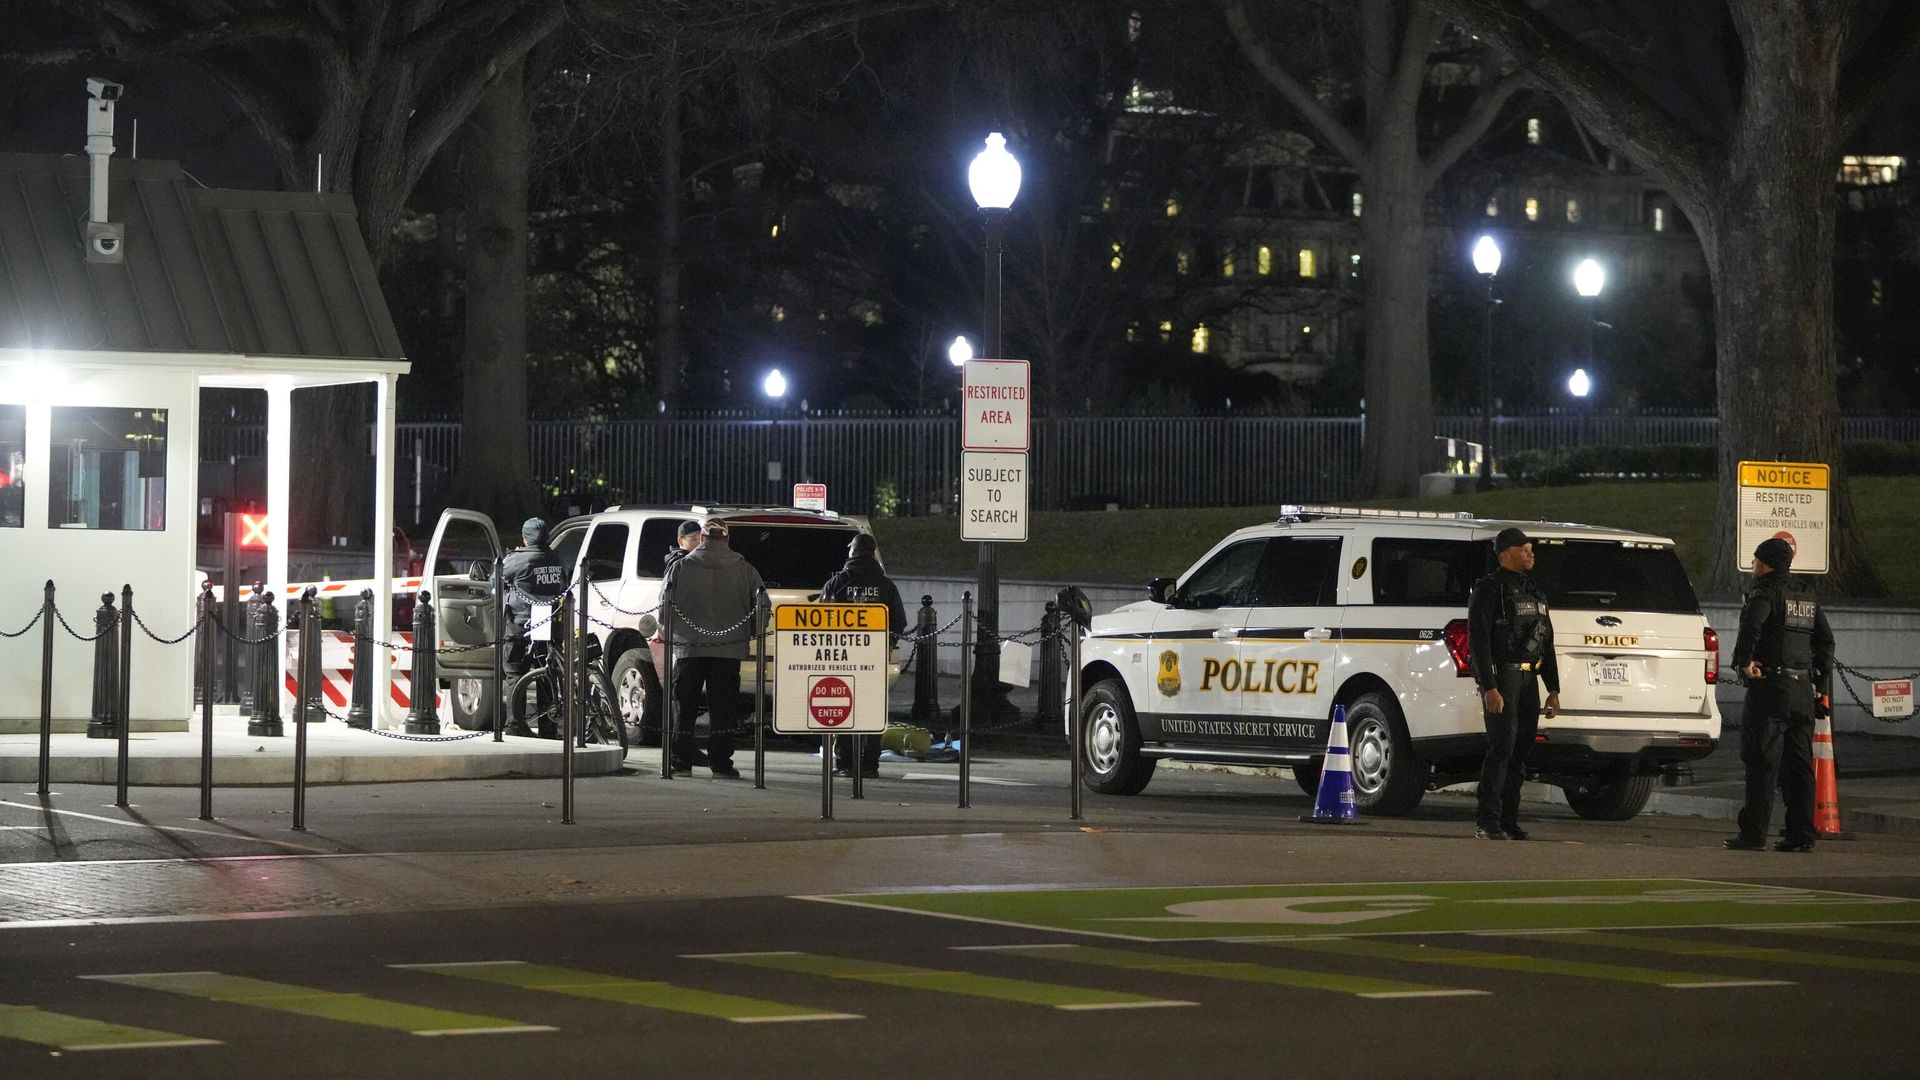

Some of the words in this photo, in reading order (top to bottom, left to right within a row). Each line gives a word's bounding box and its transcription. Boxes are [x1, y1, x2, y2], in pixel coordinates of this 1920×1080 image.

[968, 386, 1025, 400] RESTRICTED
[980, 410, 1012, 424] AREA
[968, 468, 1022, 483] SUBJECT
[1757, 470, 1811, 484] NOTICE
[987, 489, 1002, 502] TO
[1756, 492, 1812, 504] RESTRICTED
[970, 510, 1018, 523] SEARCH
[1771, 508, 1797, 518] AREA
[1745, 519, 1779, 528] AUTHORIZED
[1781, 520, 1807, 529] VEHICLES
[1809, 521, 1824, 529] ONLY
[533, 566, 548, 575] SECRET
[536, 573, 560, 585] POLICE
[1787, 603, 1815, 617] POLICE
[795, 609, 868, 628] NOTICE
[793, 633, 870, 646] RESTRICTED
[1419, 630, 1433, 638] 0625
[1584, 635, 1640, 646] POLICE
[815, 649, 848, 661] AREA
[1199, 657, 1320, 695] POLICE
[1602, 668, 1626, 680] 0625Z
[816, 687, 826, 695] DO
[831, 687, 847, 695] NOT
[818, 709, 843, 717] ENTER
[1161, 719, 1196, 734] UNITED
[1198, 720, 1231, 735] STATES
[1234, 722, 1270, 736] SECRET
[1273, 723, 1315, 738] SERVICE
